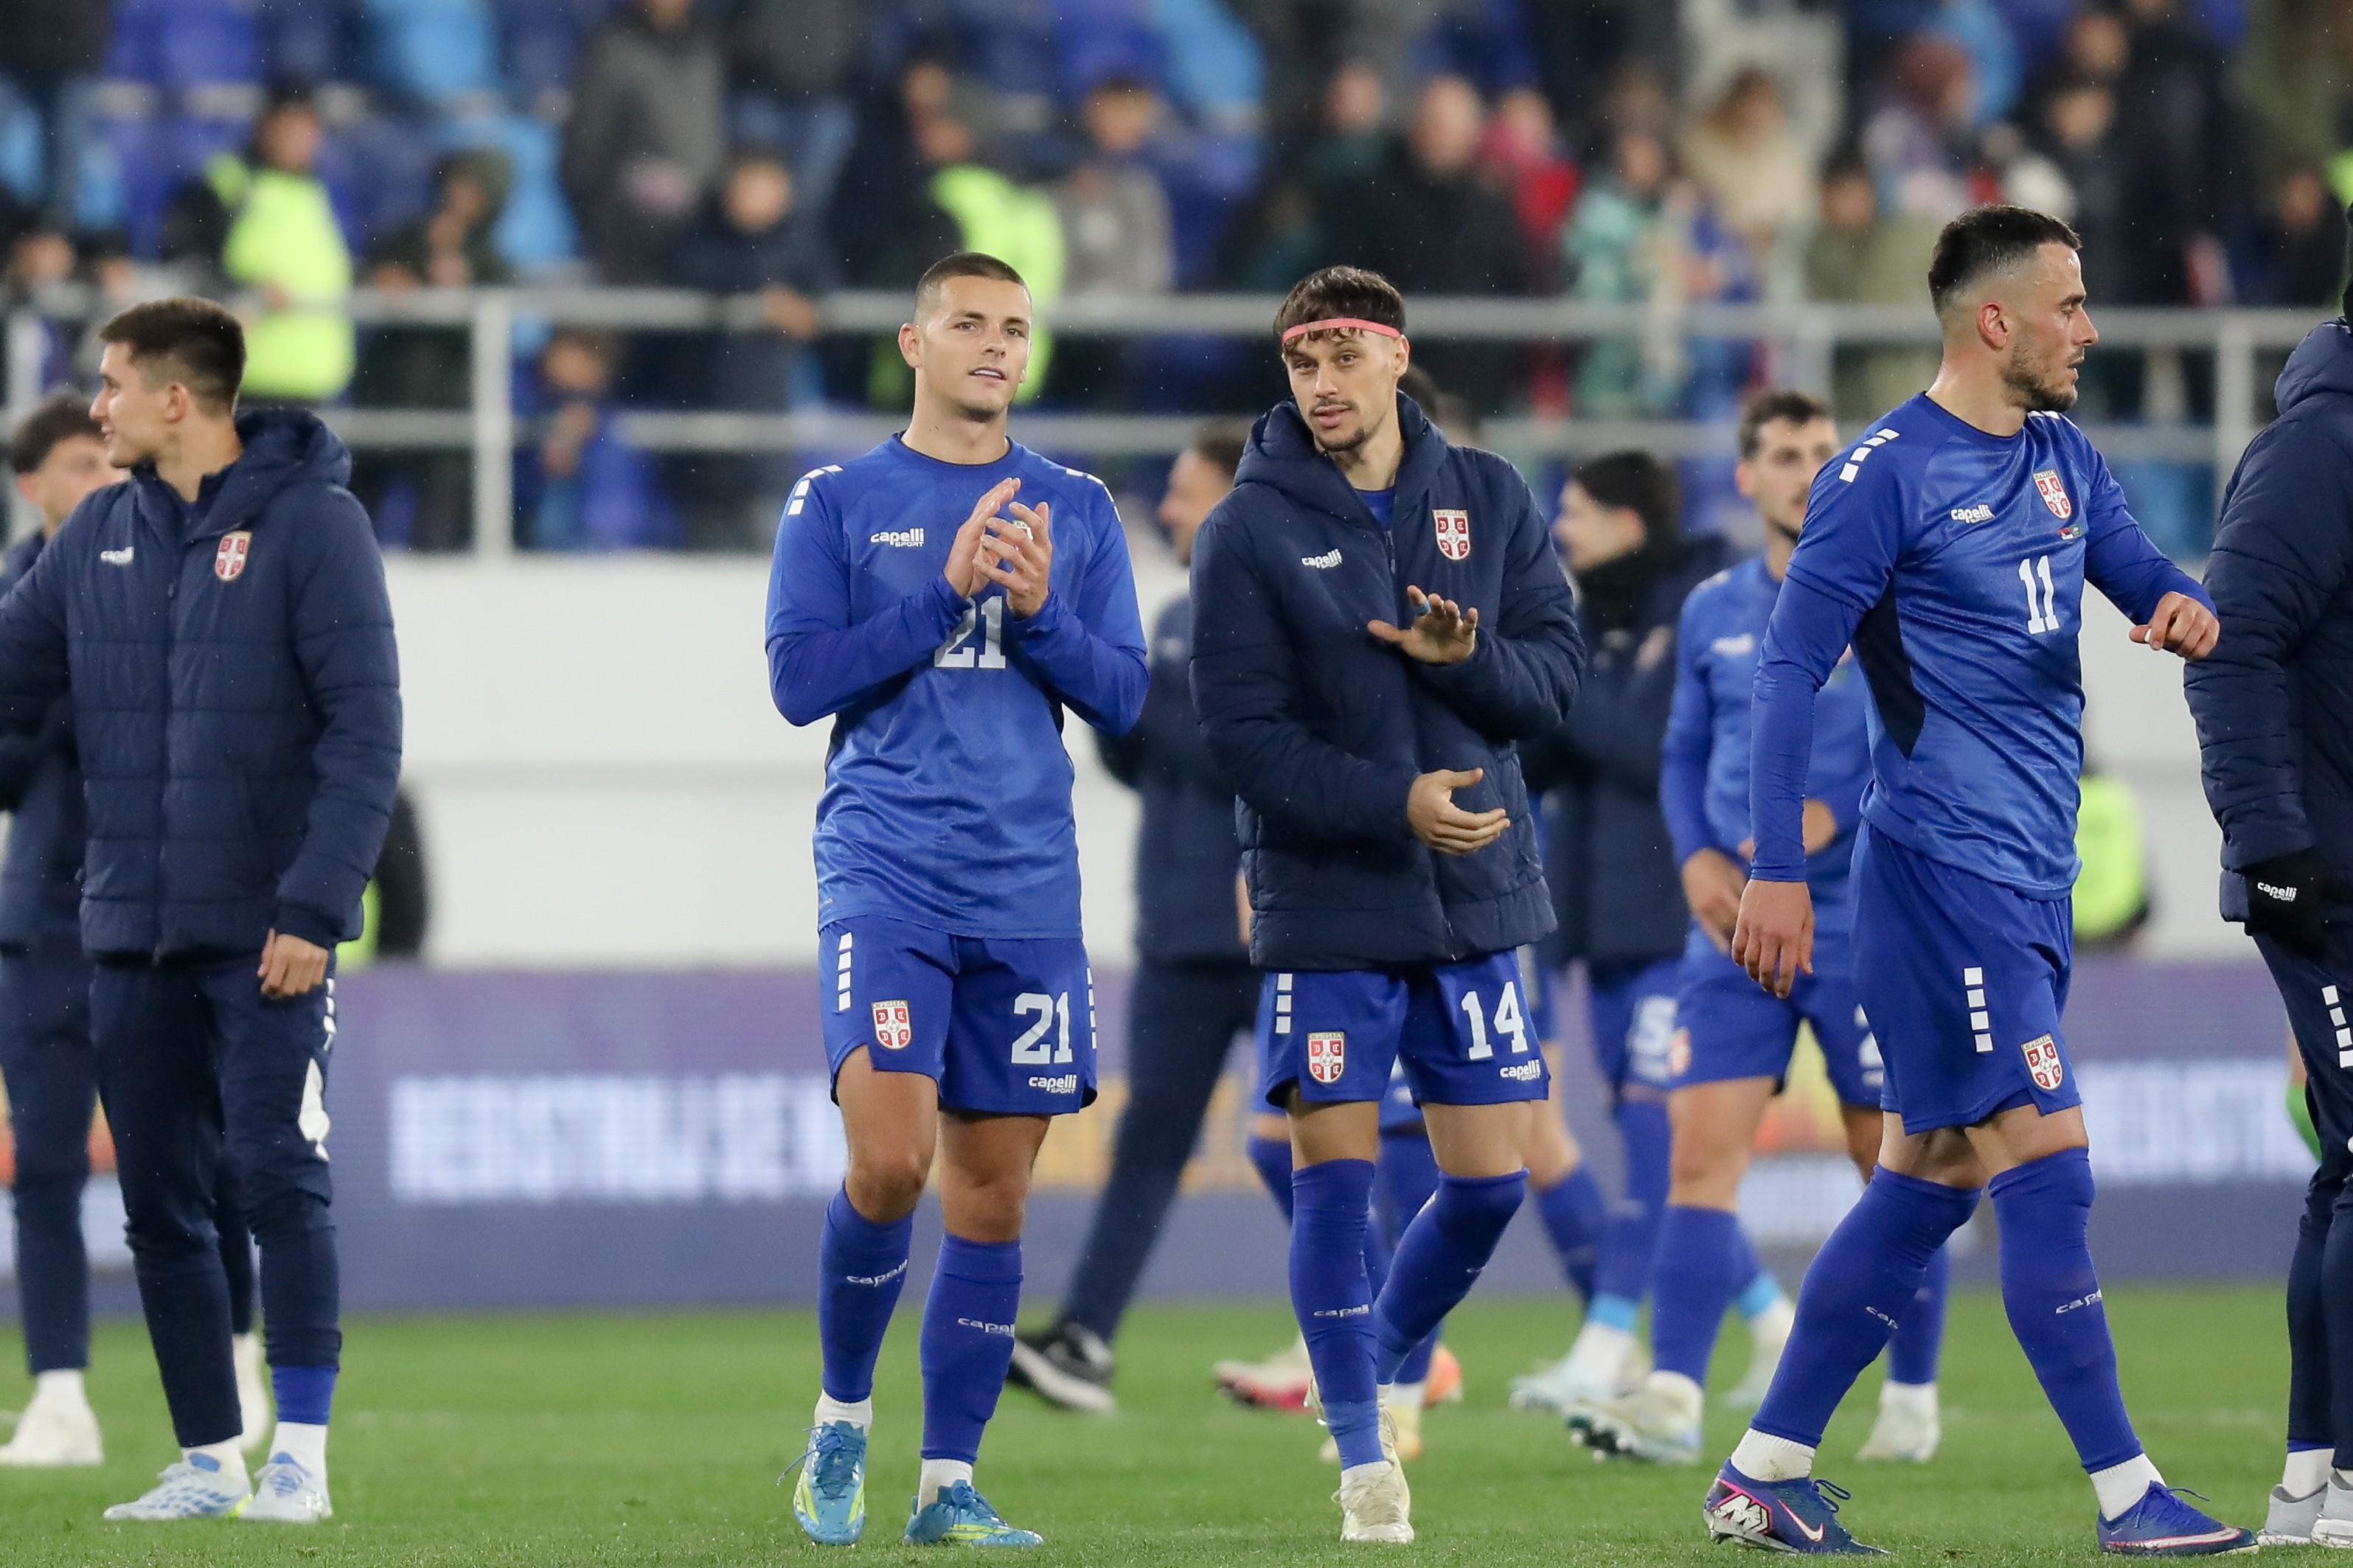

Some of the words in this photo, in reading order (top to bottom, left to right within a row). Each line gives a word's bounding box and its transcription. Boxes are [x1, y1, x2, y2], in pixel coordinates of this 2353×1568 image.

[1950, 504, 1996, 524] capelli
[870, 528, 925, 546] capelli
[1301, 548, 1343, 569] capelli
[2018, 555, 2060, 634] 11
[934, 596, 1007, 669] 21
[2257, 882, 2298, 897] capelli
[1011, 991, 1073, 1064] 21
[1461, 980, 1528, 1060] 14
[1499, 1059, 1541, 1081] capelli
[1028, 1074, 1077, 1092] capelli
